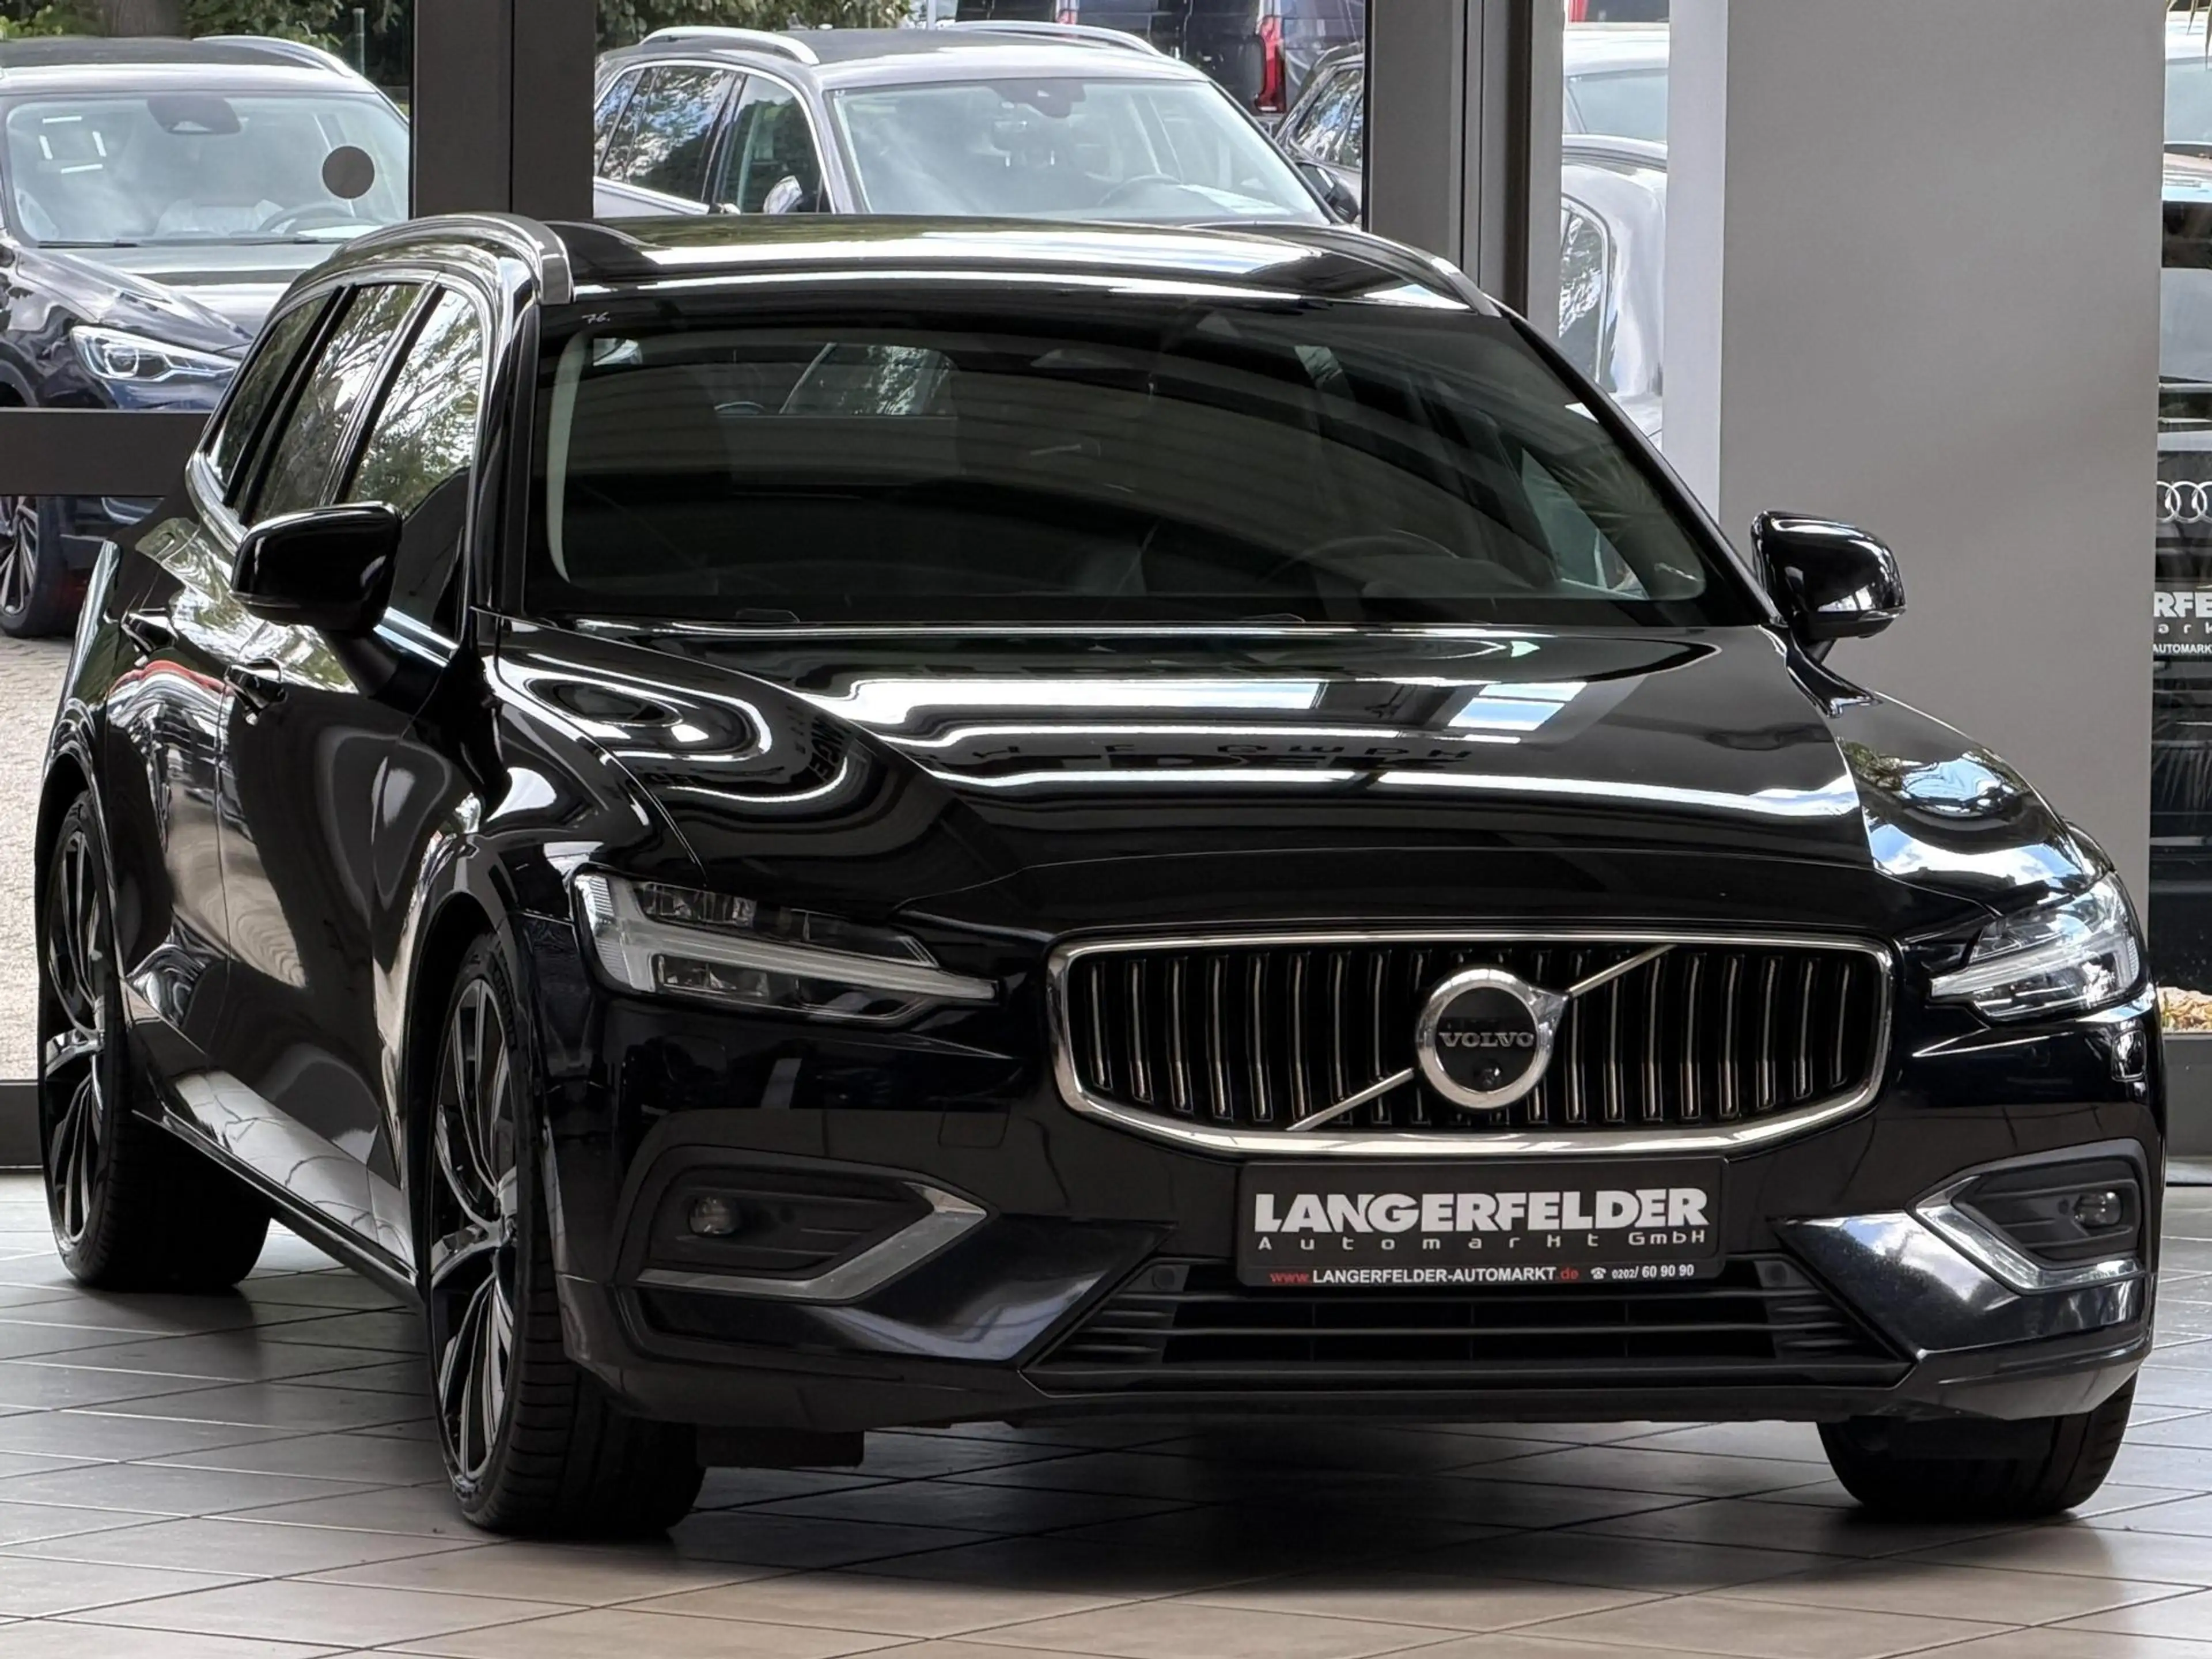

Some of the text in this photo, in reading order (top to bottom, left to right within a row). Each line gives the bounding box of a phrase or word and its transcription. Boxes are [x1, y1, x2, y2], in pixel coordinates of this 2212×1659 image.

[1438, 1032, 1534, 1047] VOLVO
[1255, 1188, 1710, 1233] LANGERFELDER
[1628, 1229, 1705, 1246] GmbH
[1642, 1266, 1657, 1278] 60
[1660, 1264, 1676, 1277] 90
[1679, 1264, 1694, 1277] 90
